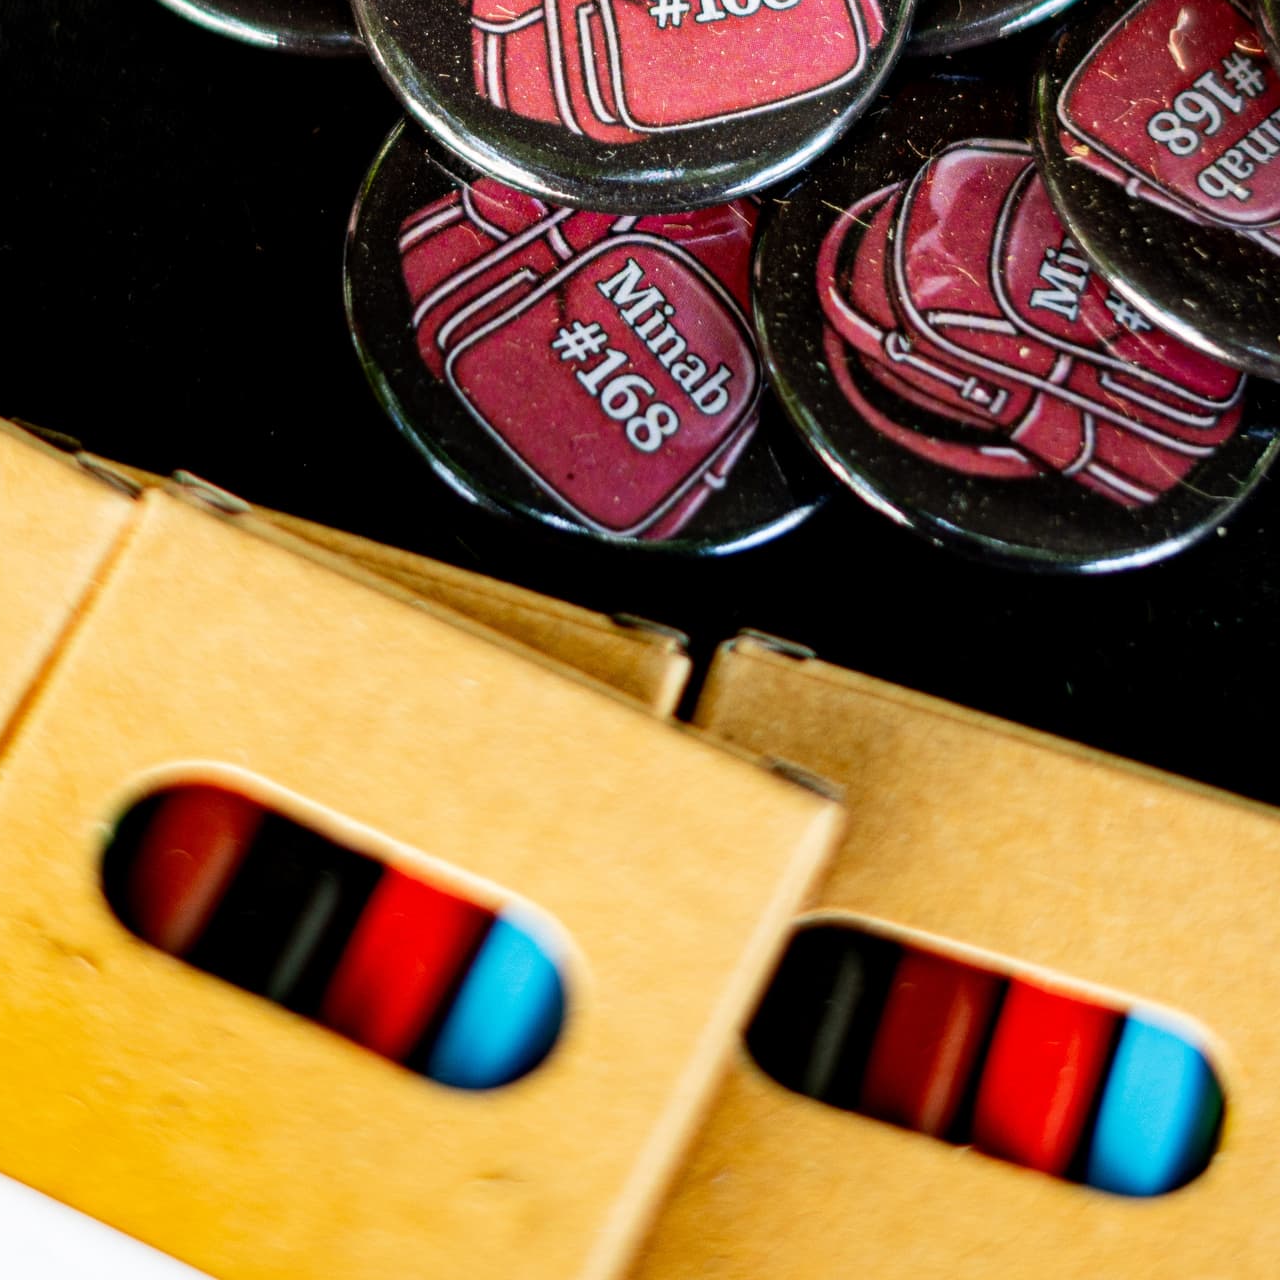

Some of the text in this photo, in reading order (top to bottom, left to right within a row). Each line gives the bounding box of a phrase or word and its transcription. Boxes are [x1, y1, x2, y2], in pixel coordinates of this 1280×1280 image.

[1147, 51, 1265, 157] #168
[551, 320, 679, 453] #168
[596, 257, 733, 415] Minab
